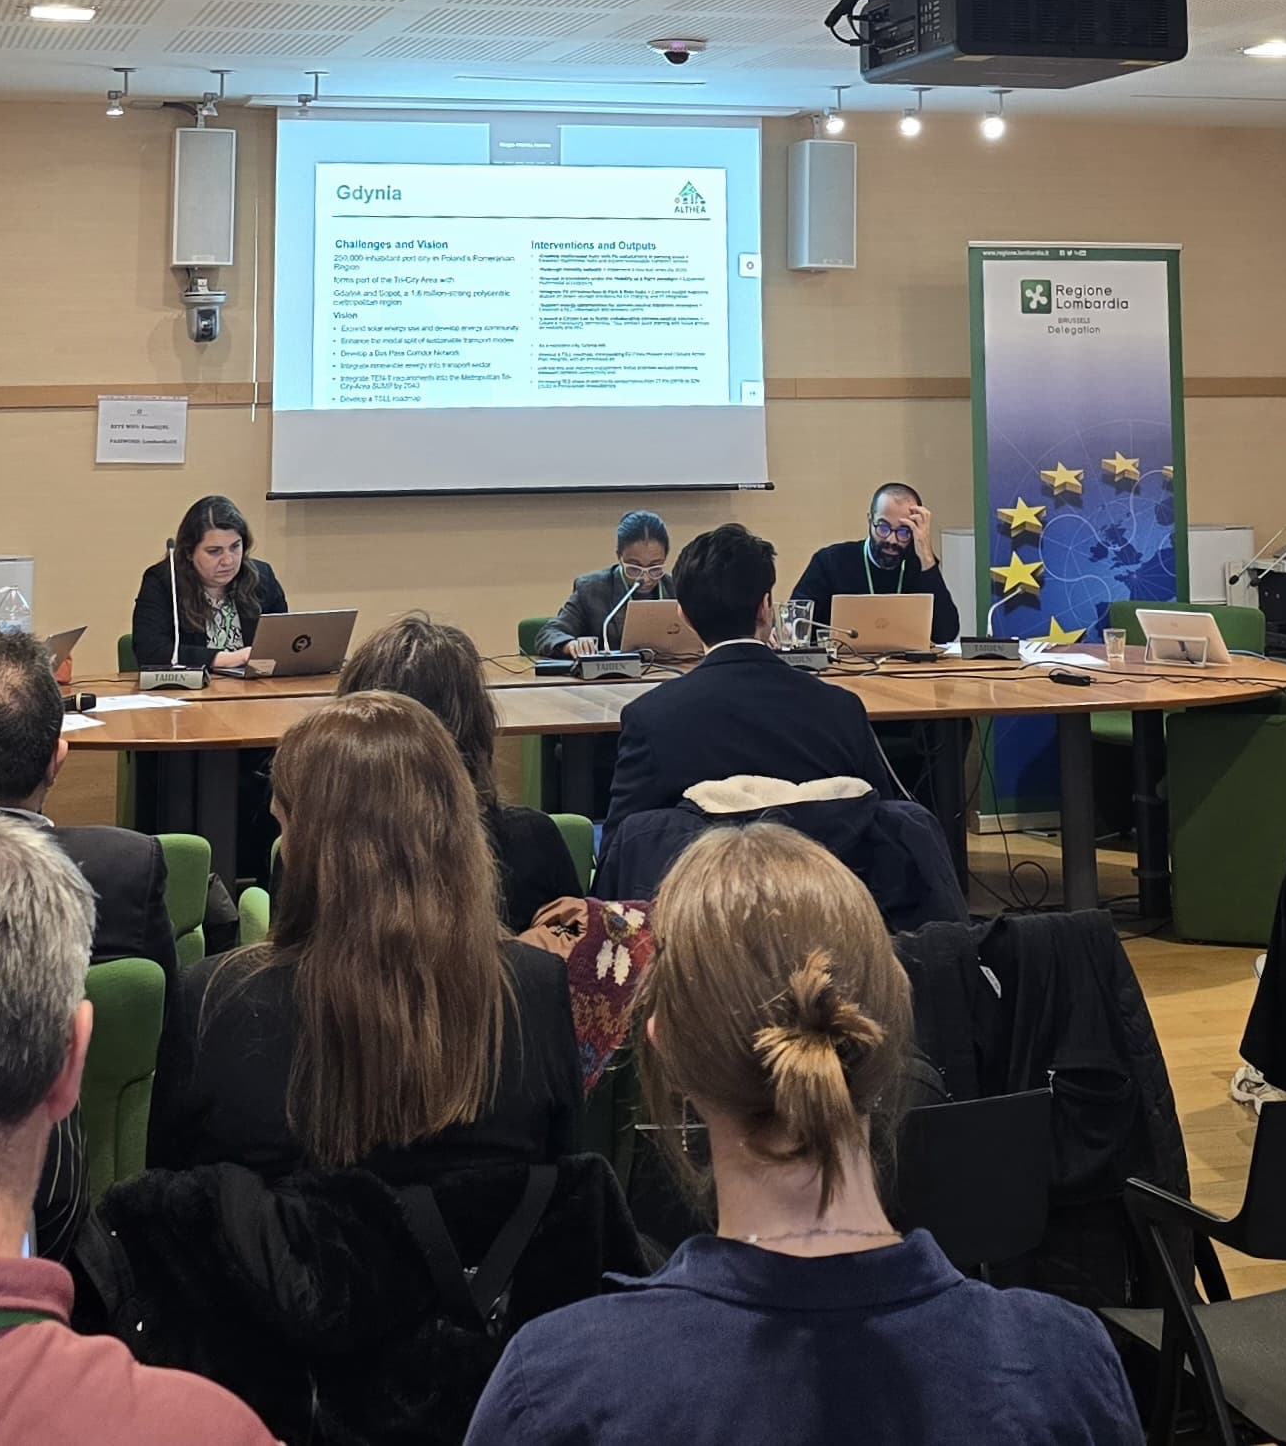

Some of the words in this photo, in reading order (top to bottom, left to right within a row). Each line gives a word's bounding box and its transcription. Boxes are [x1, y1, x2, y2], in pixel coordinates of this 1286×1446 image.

[336, 184, 402, 204] Gdynia
[674, 205, 707, 214] ALTHEA
[335, 239, 392, 251] Challenges
[395, 239, 414, 249] and
[416, 239, 449, 249] Vision
[531, 240, 595, 250] Interventions
[598, 241, 616, 250] and
[618, 240, 657, 252] Outputs
[355, 277, 370, 285] part
[1055, 284, 1113, 298] Regione
[1056, 297, 1129, 309] Lombardia
[333, 311, 358, 319] Vision
[1047, 325, 1101, 335] Delegation
